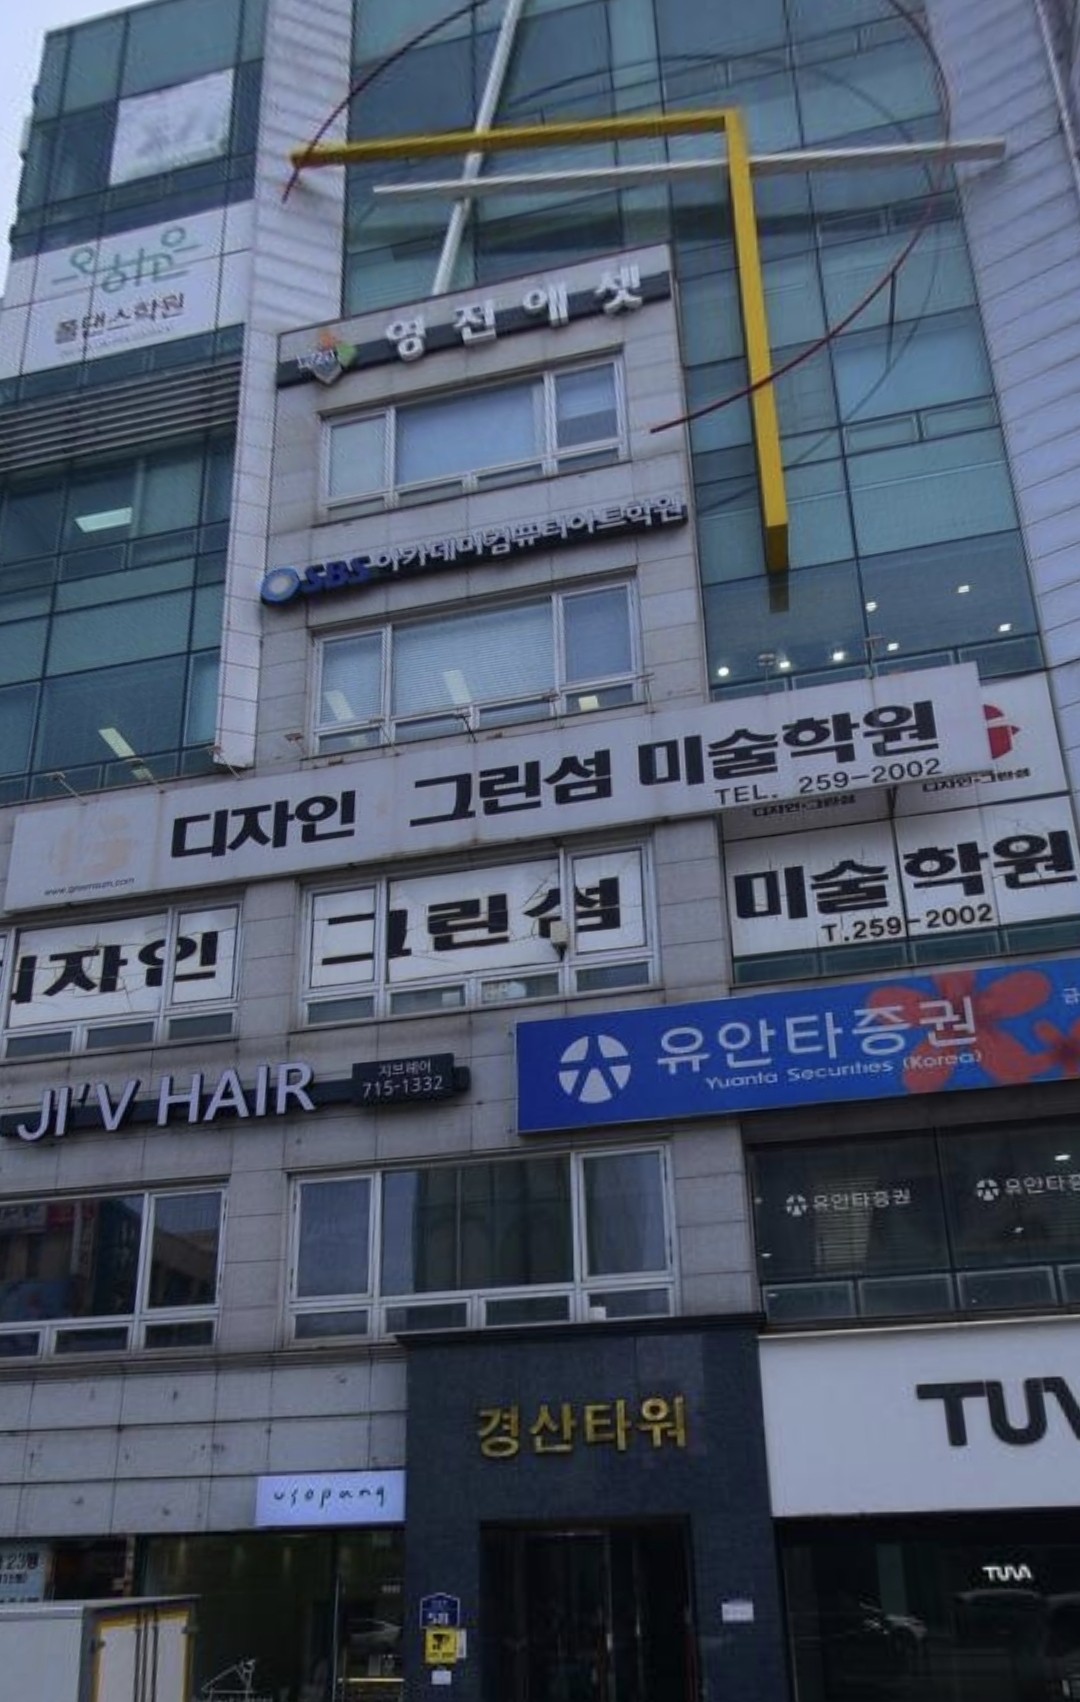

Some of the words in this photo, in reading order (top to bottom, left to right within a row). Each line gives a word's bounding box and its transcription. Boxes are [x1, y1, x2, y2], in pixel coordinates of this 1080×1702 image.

[171, 790, 356, 858] 디자인
[409, 749, 612, 827] 그린섬
[638, 700, 939, 786] 미술학원
[715, 785, 778, 806] TEL.
[798, 757, 942, 793] 259-2002
[733, 829, 1078, 919] 미술학원
[321, 877, 621, 966] 그린섬
[656, 995, 977, 1076] 유안타증권
[156, 1061, 316, 1127] HAIR
[361, 1075, 444, 1099] 715-1332
[705, 1071, 778, 1091] Yuanta
[786, 1059, 894, 1083] Securities
[902, 1049, 982, 1072] (Korea)
[476, 1395, 687, 1458] 경산타워
